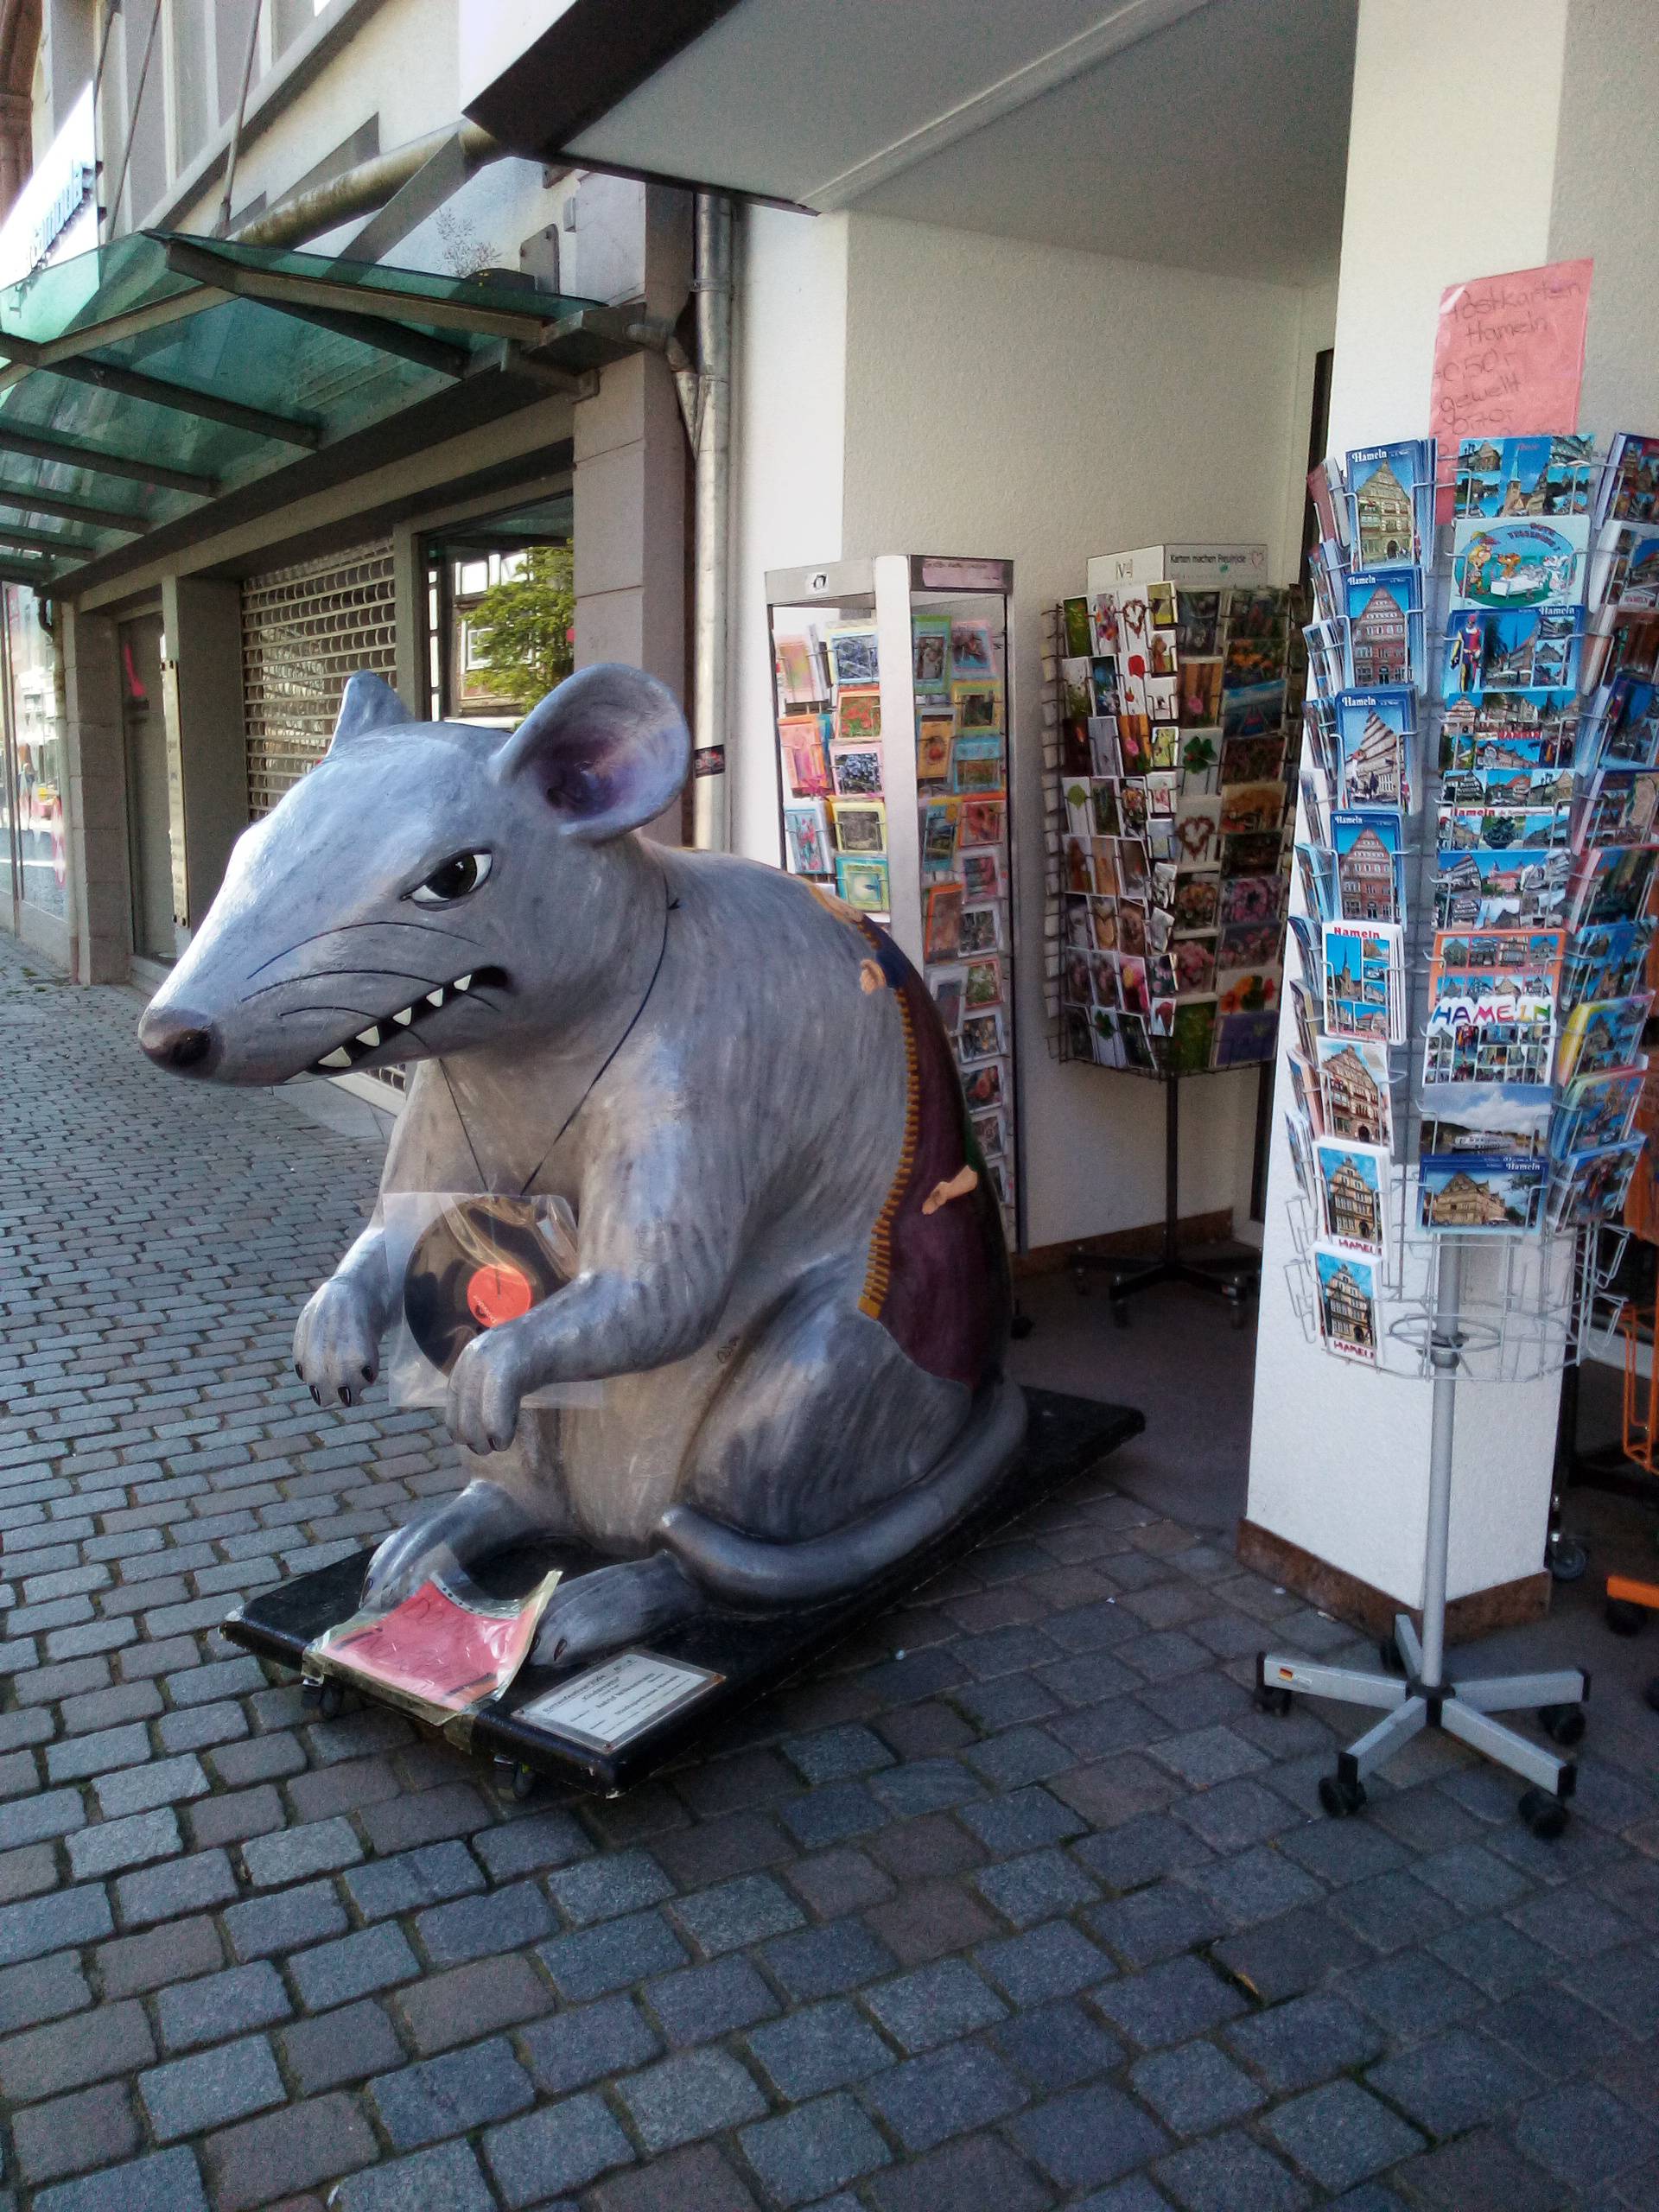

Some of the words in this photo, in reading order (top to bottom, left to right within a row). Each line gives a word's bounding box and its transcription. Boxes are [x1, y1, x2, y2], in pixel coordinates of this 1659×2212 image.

[1466, 311, 1548, 344] Hameln
[1351, 448, 1388, 463] Hameln
[1348, 575, 1376, 586] Hameln
[1539, 606, 1576, 617] Hameln
[1342, 696, 1376, 707] Hameln
[1335, 815, 1363, 825] Hameln
[1333, 926, 1381, 940] Hameln
[1431, 1003, 1553, 1025] HAMELN
[1506, 1162, 1541, 1171] Hameln
